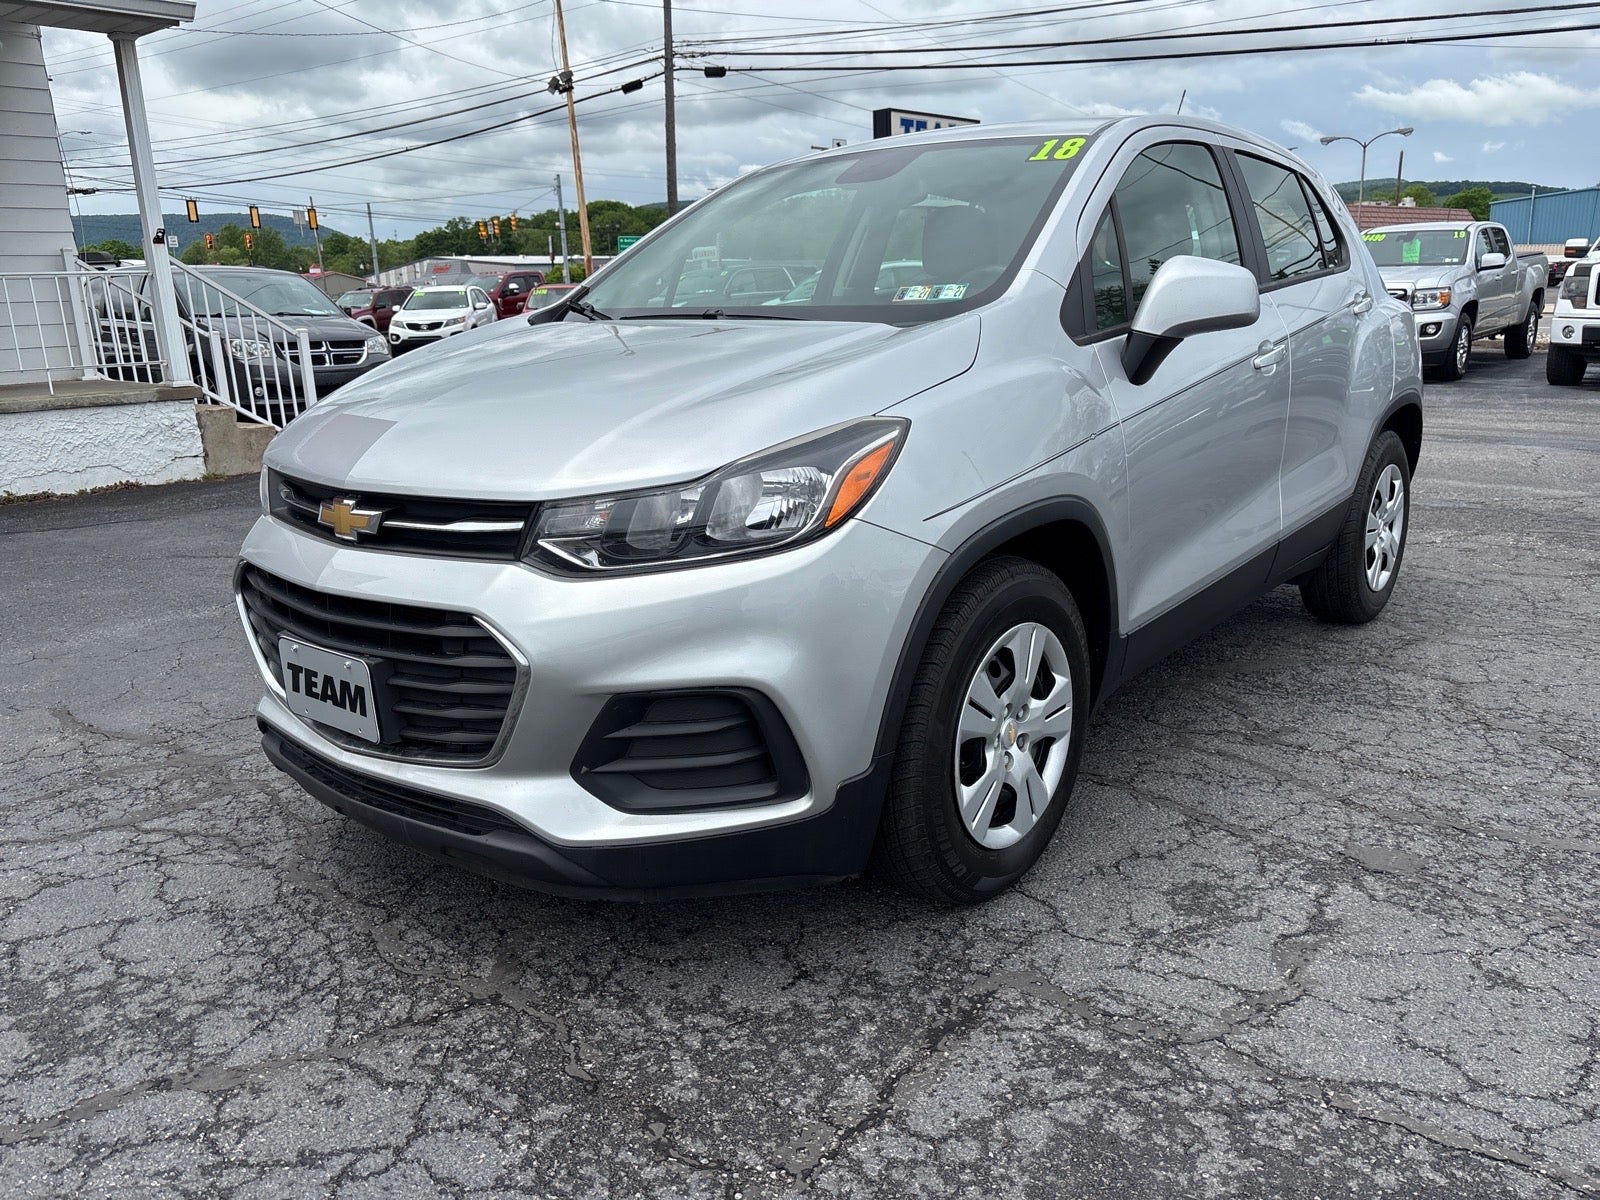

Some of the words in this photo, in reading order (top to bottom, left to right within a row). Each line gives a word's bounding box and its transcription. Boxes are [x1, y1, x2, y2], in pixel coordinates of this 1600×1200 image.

[900, 117, 956, 134] TE
[1028, 137, 1087, 161] 18
[287, 662, 367, 717] TEAM
